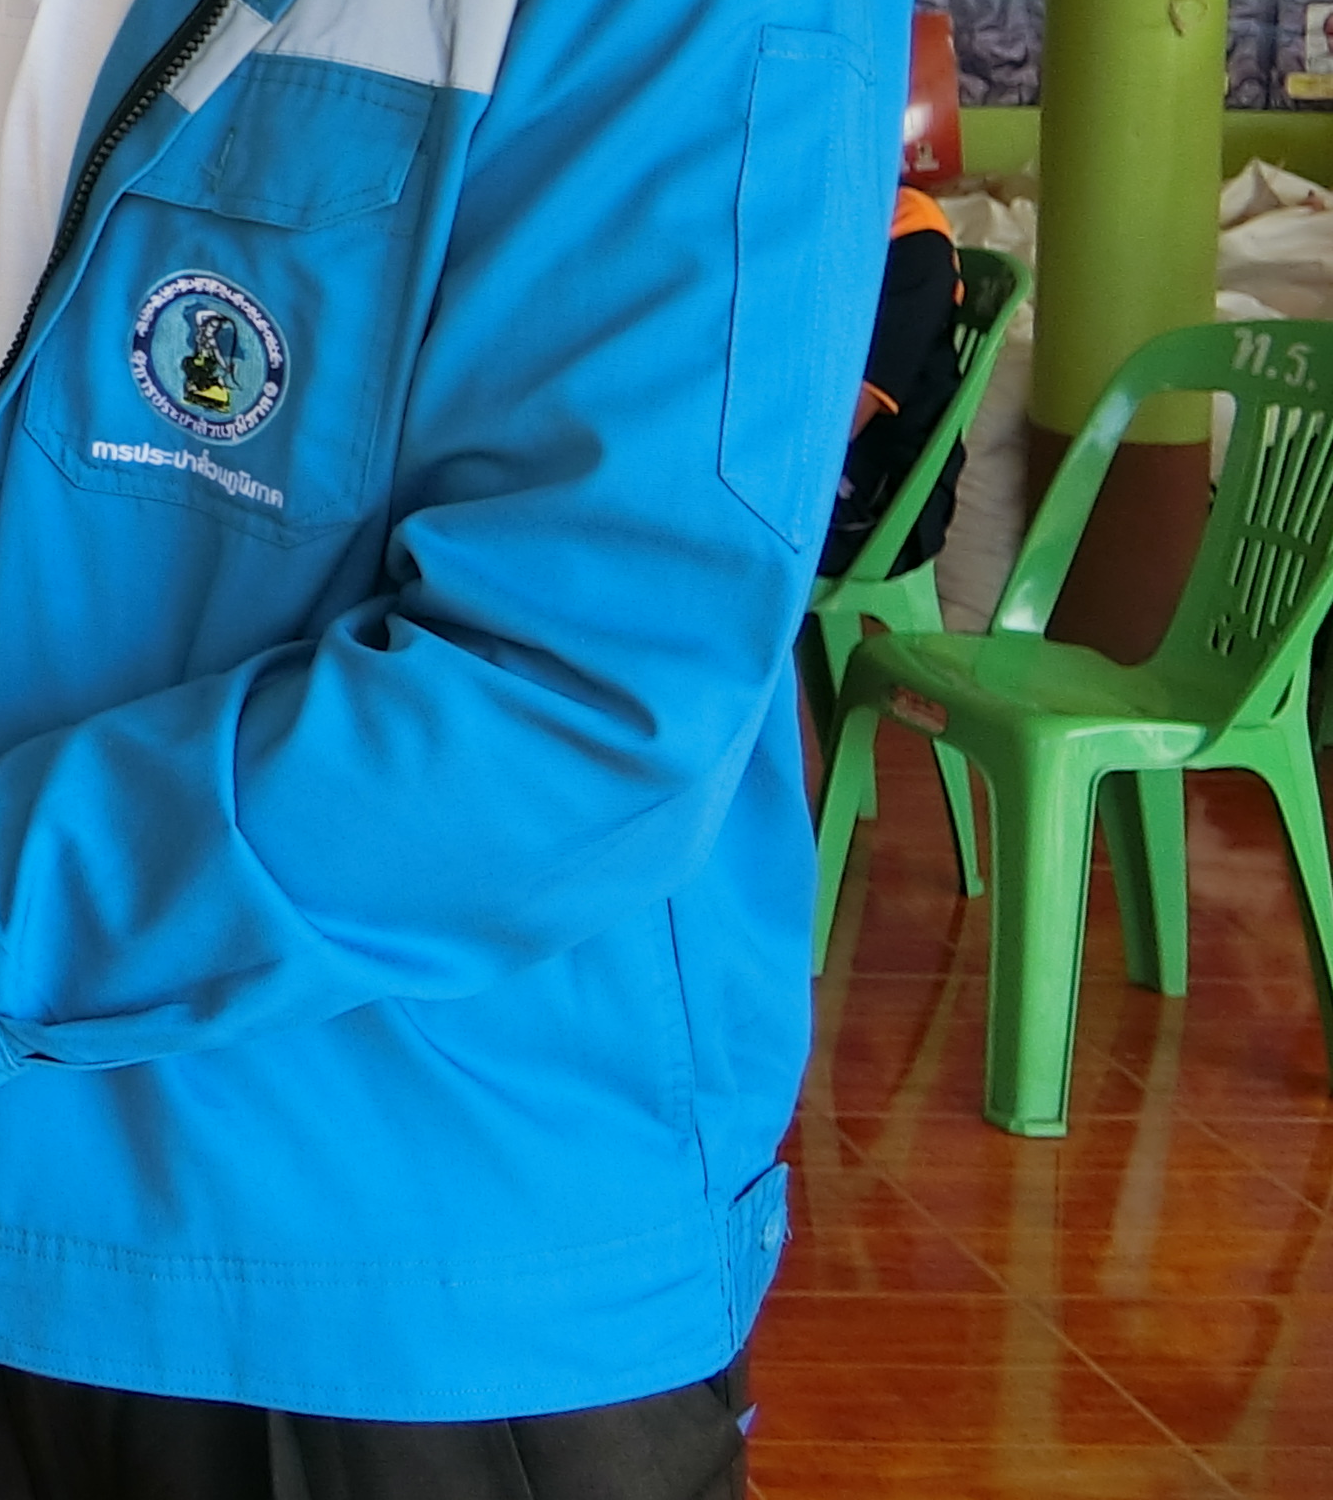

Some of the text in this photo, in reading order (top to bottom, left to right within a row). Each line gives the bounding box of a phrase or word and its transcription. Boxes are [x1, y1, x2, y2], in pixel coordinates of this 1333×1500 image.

[91, 439, 284, 509] การประปาส่วนภูมิภาค
